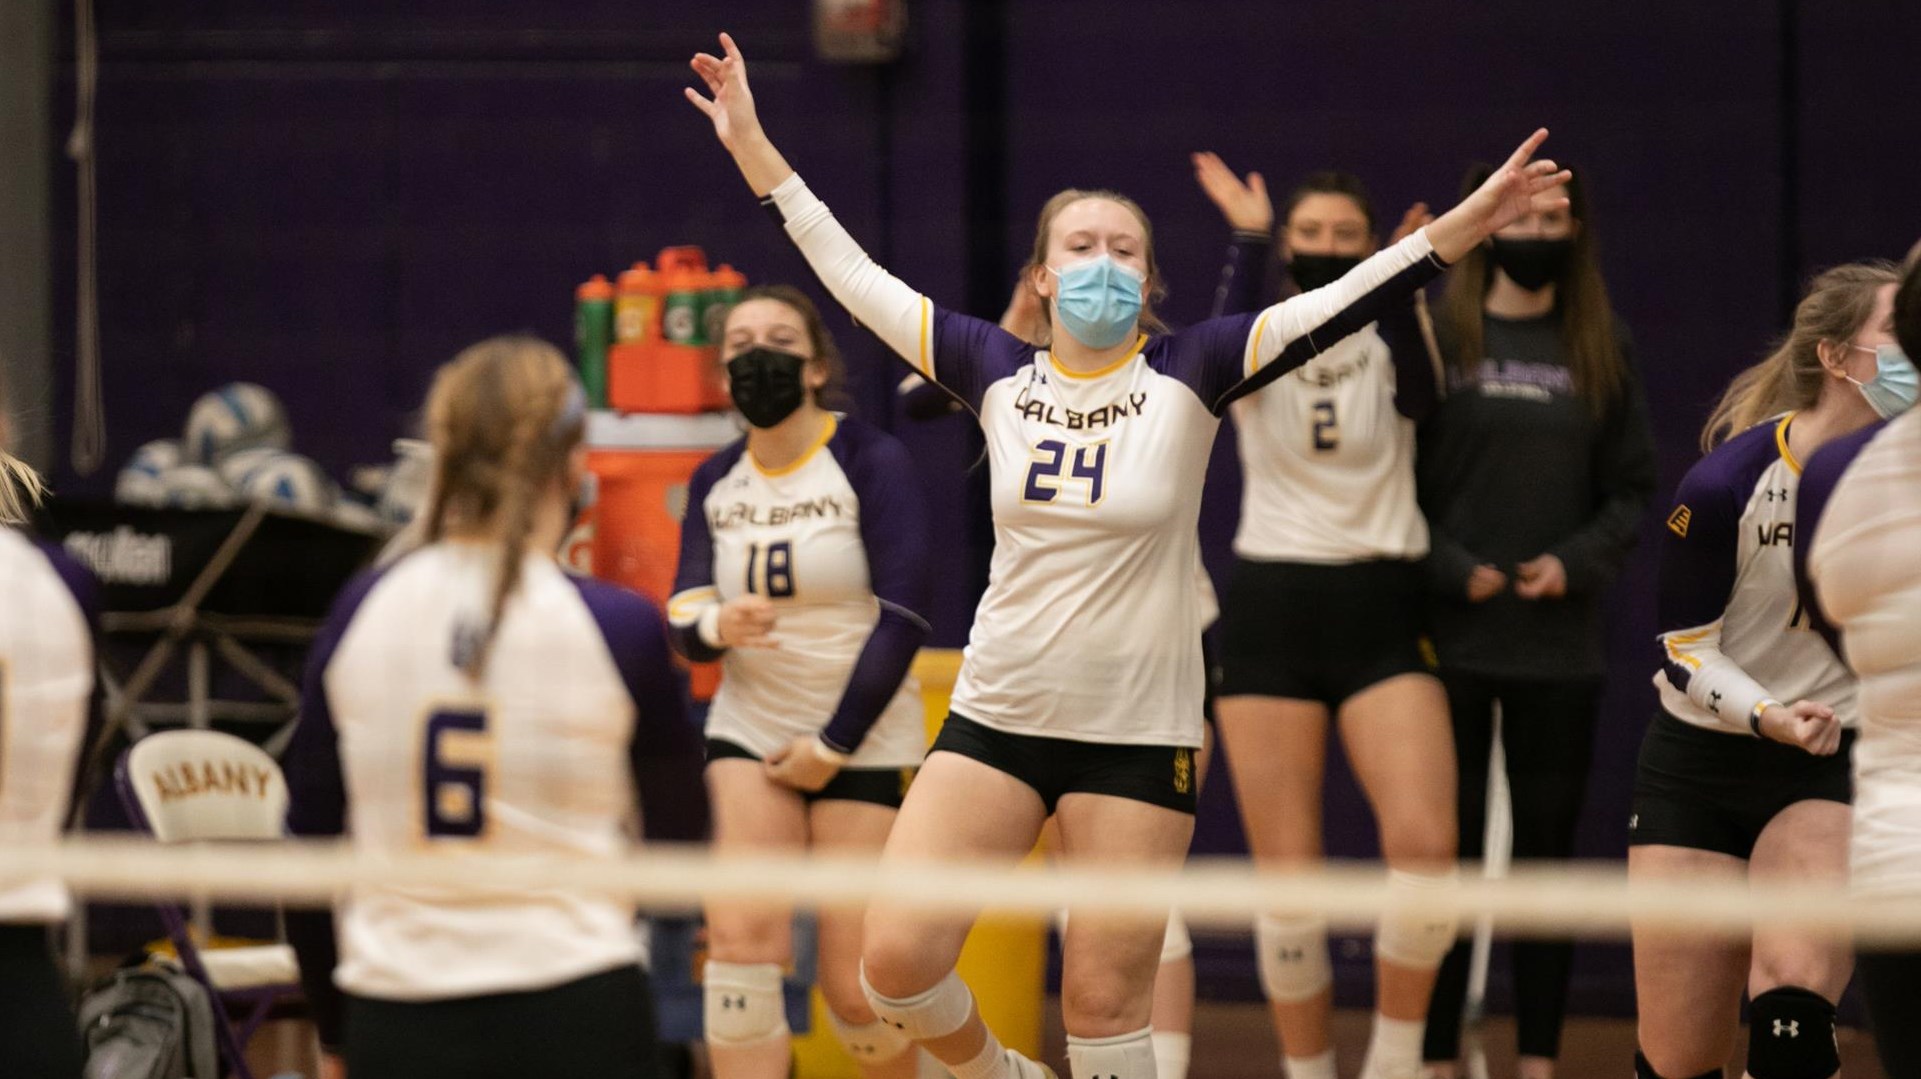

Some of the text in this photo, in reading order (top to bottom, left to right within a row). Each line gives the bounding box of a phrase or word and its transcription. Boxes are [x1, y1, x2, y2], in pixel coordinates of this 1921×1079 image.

[1311, 401, 1338, 451] 2
[1020, 438, 1112, 508] 24
[745, 539, 797, 599] 18
[153, 759, 270, 803] ALBANY
[420, 704, 491, 842] 6
